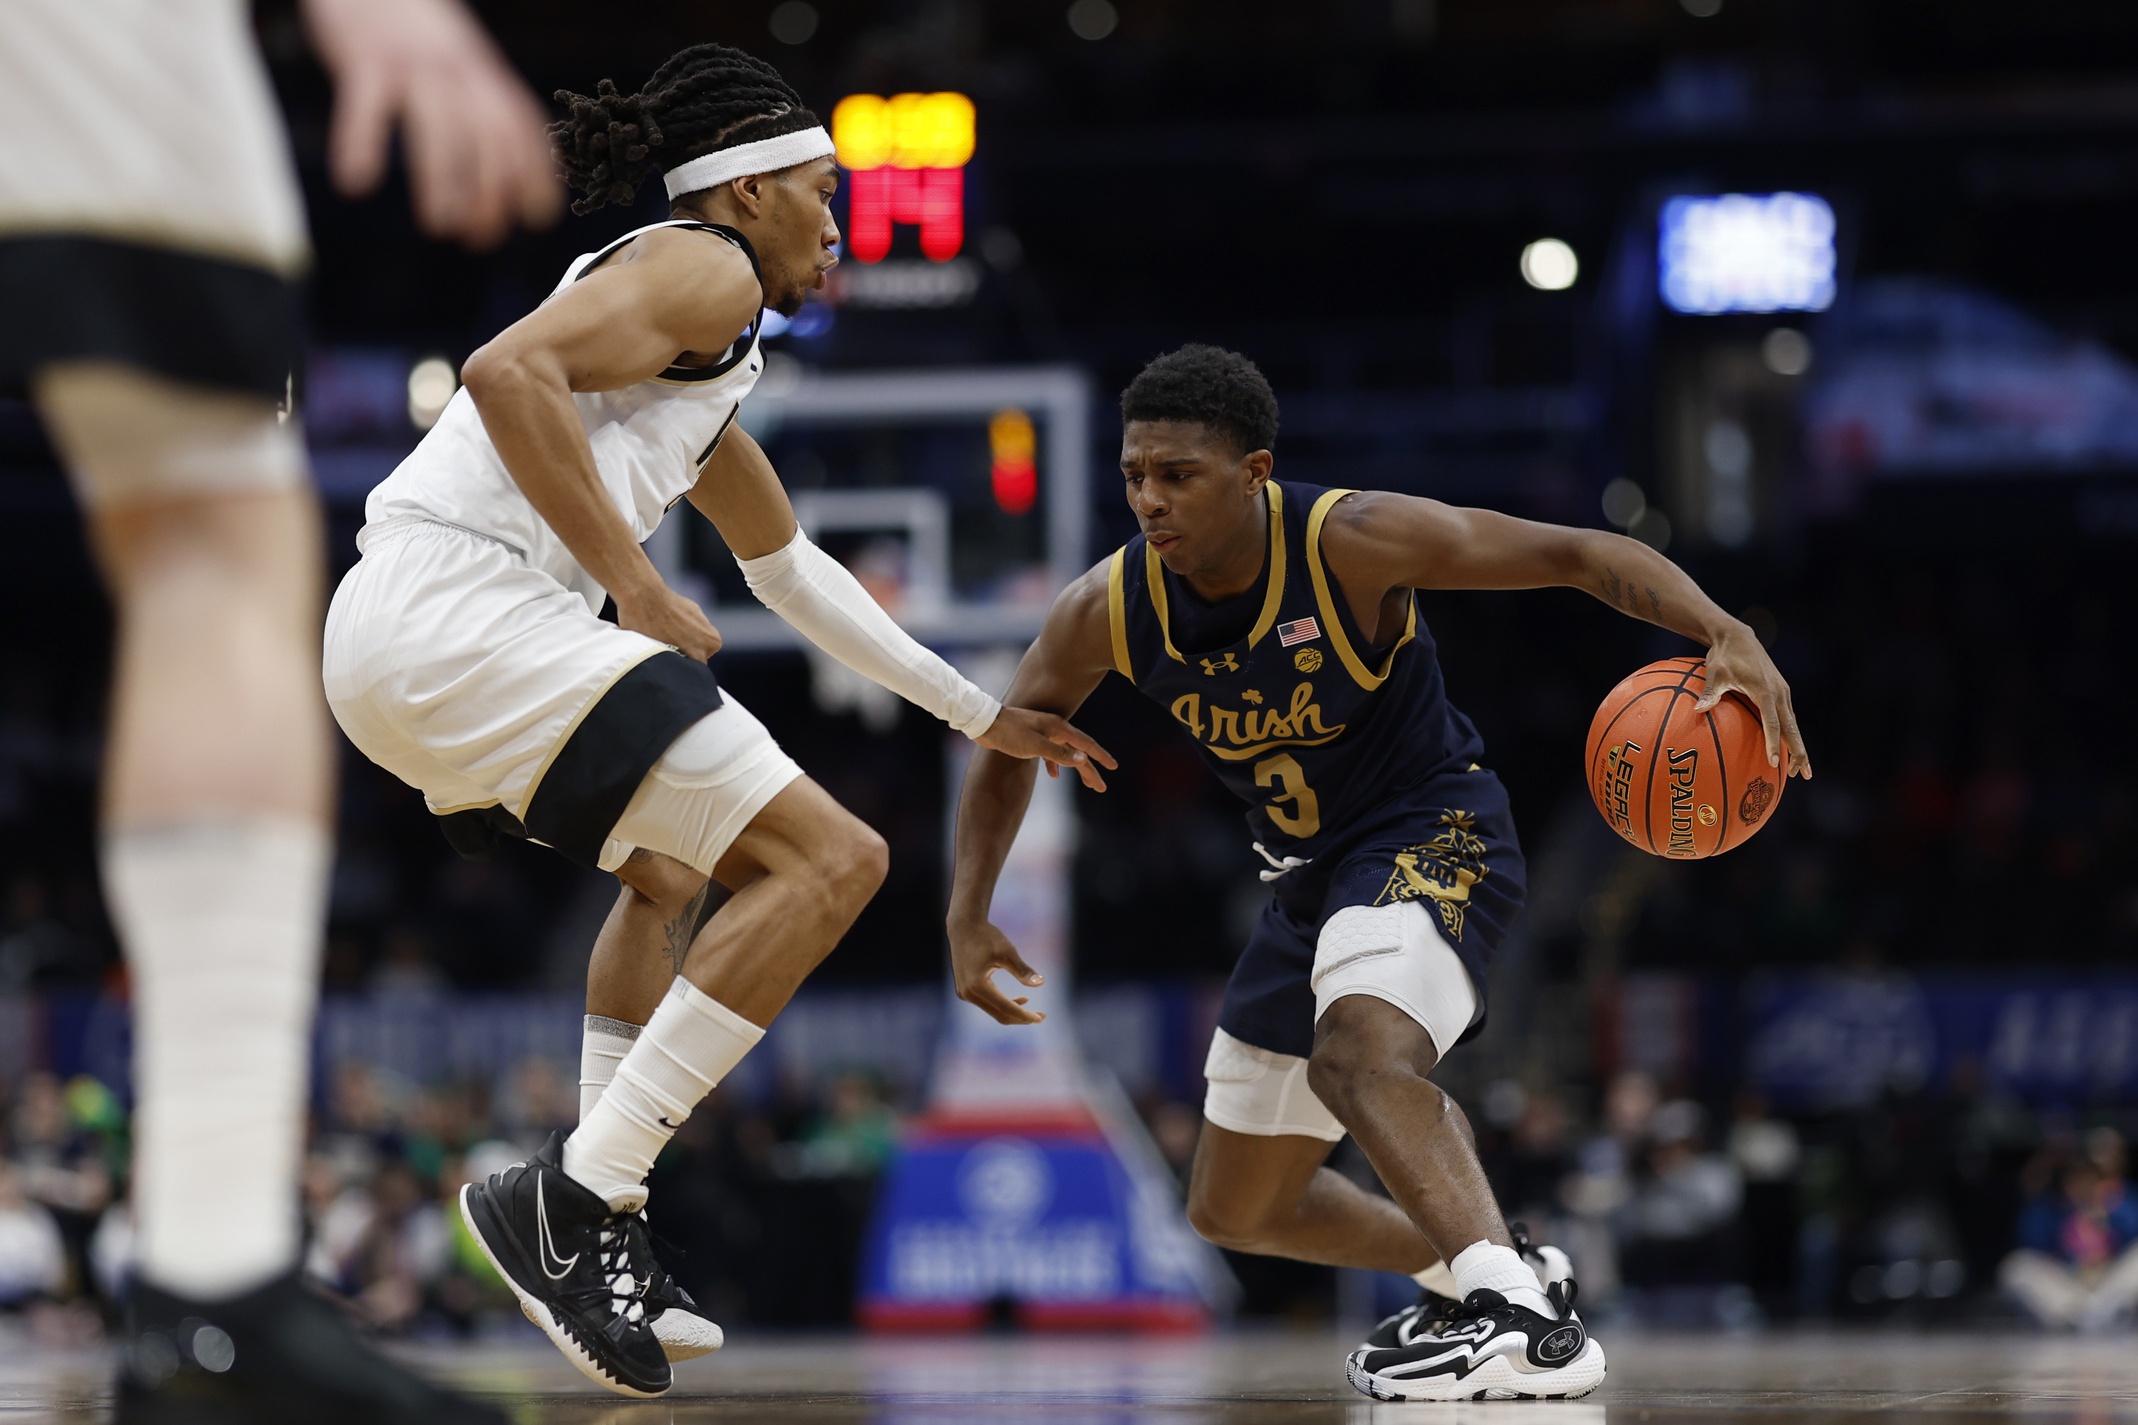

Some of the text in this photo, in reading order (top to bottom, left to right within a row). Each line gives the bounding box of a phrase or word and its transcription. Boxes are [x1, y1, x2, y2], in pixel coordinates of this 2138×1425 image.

[1298, 651, 1320, 665] ACC
[1171, 682, 1346, 761] Irish
[1254, 752, 1321, 839] 3
[1614, 740, 1642, 843] LEGACY
[1665, 747, 1699, 857] SPALDING
